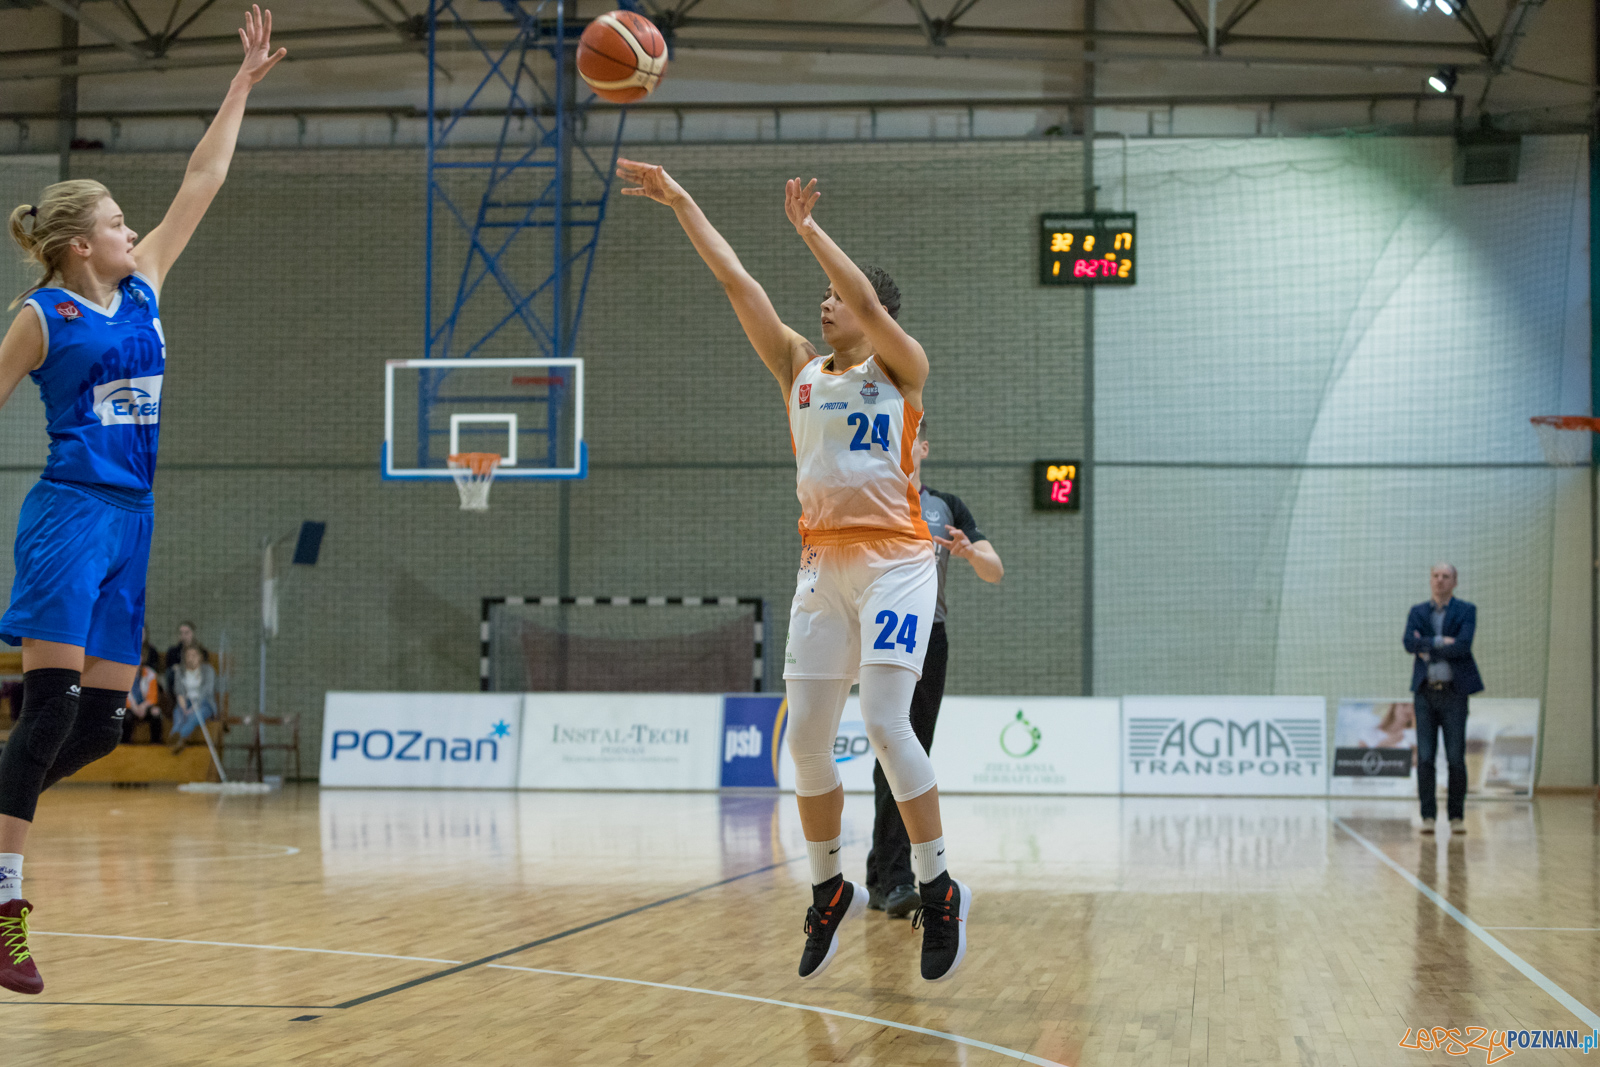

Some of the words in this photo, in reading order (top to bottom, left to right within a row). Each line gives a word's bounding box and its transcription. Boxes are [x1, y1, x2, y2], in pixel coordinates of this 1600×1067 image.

[1050, 232, 1074, 252] 32
[1114, 232, 1132, 250] 17
[1118, 259, 1132, 277] 2
[823, 402, 848, 410] PROTON
[847, 412, 890, 452] 24
[1051, 480, 1073, 504] 12
[873, 609, 918, 654] 24
[725, 724, 762, 763] psb
[1161, 718, 1291, 758] AGMA
[1130, 760, 1321, 775] TRANSPORT
